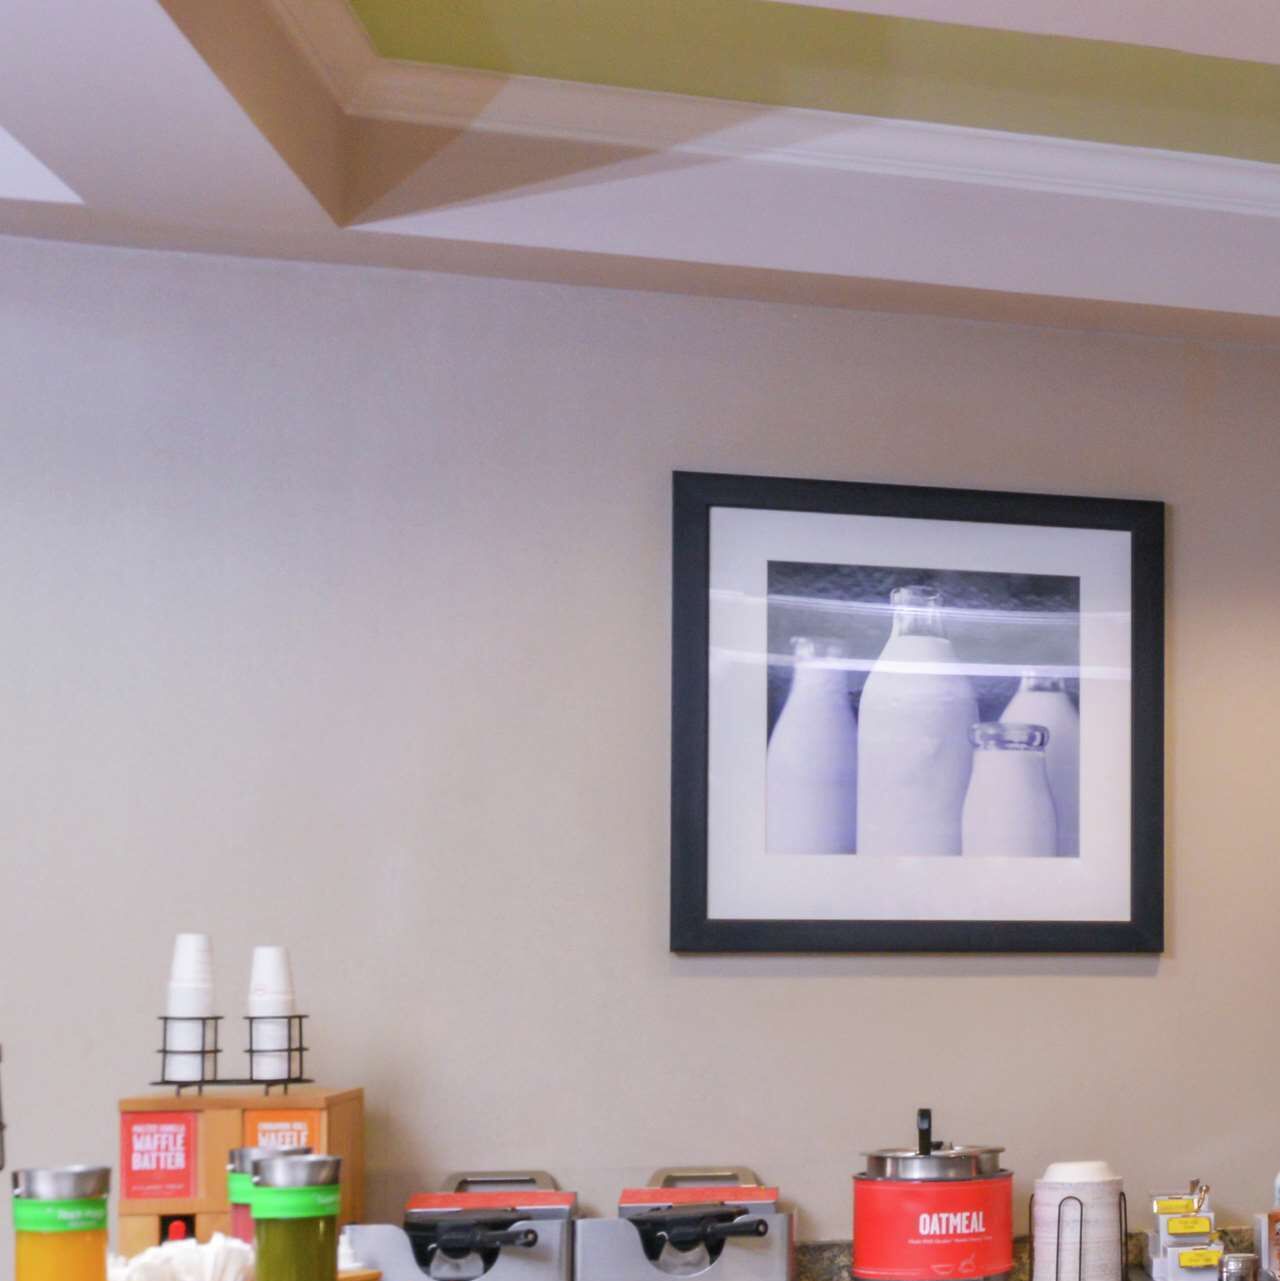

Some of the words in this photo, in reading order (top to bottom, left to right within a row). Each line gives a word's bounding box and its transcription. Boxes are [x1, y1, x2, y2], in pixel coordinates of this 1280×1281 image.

[132, 1133, 185, 1151] WAFFLE
[257, 1130, 308, 1149] WAFFLE
[131, 1152, 186, 1171] BATTER
[919, 1212, 986, 1235] OATMEAL
